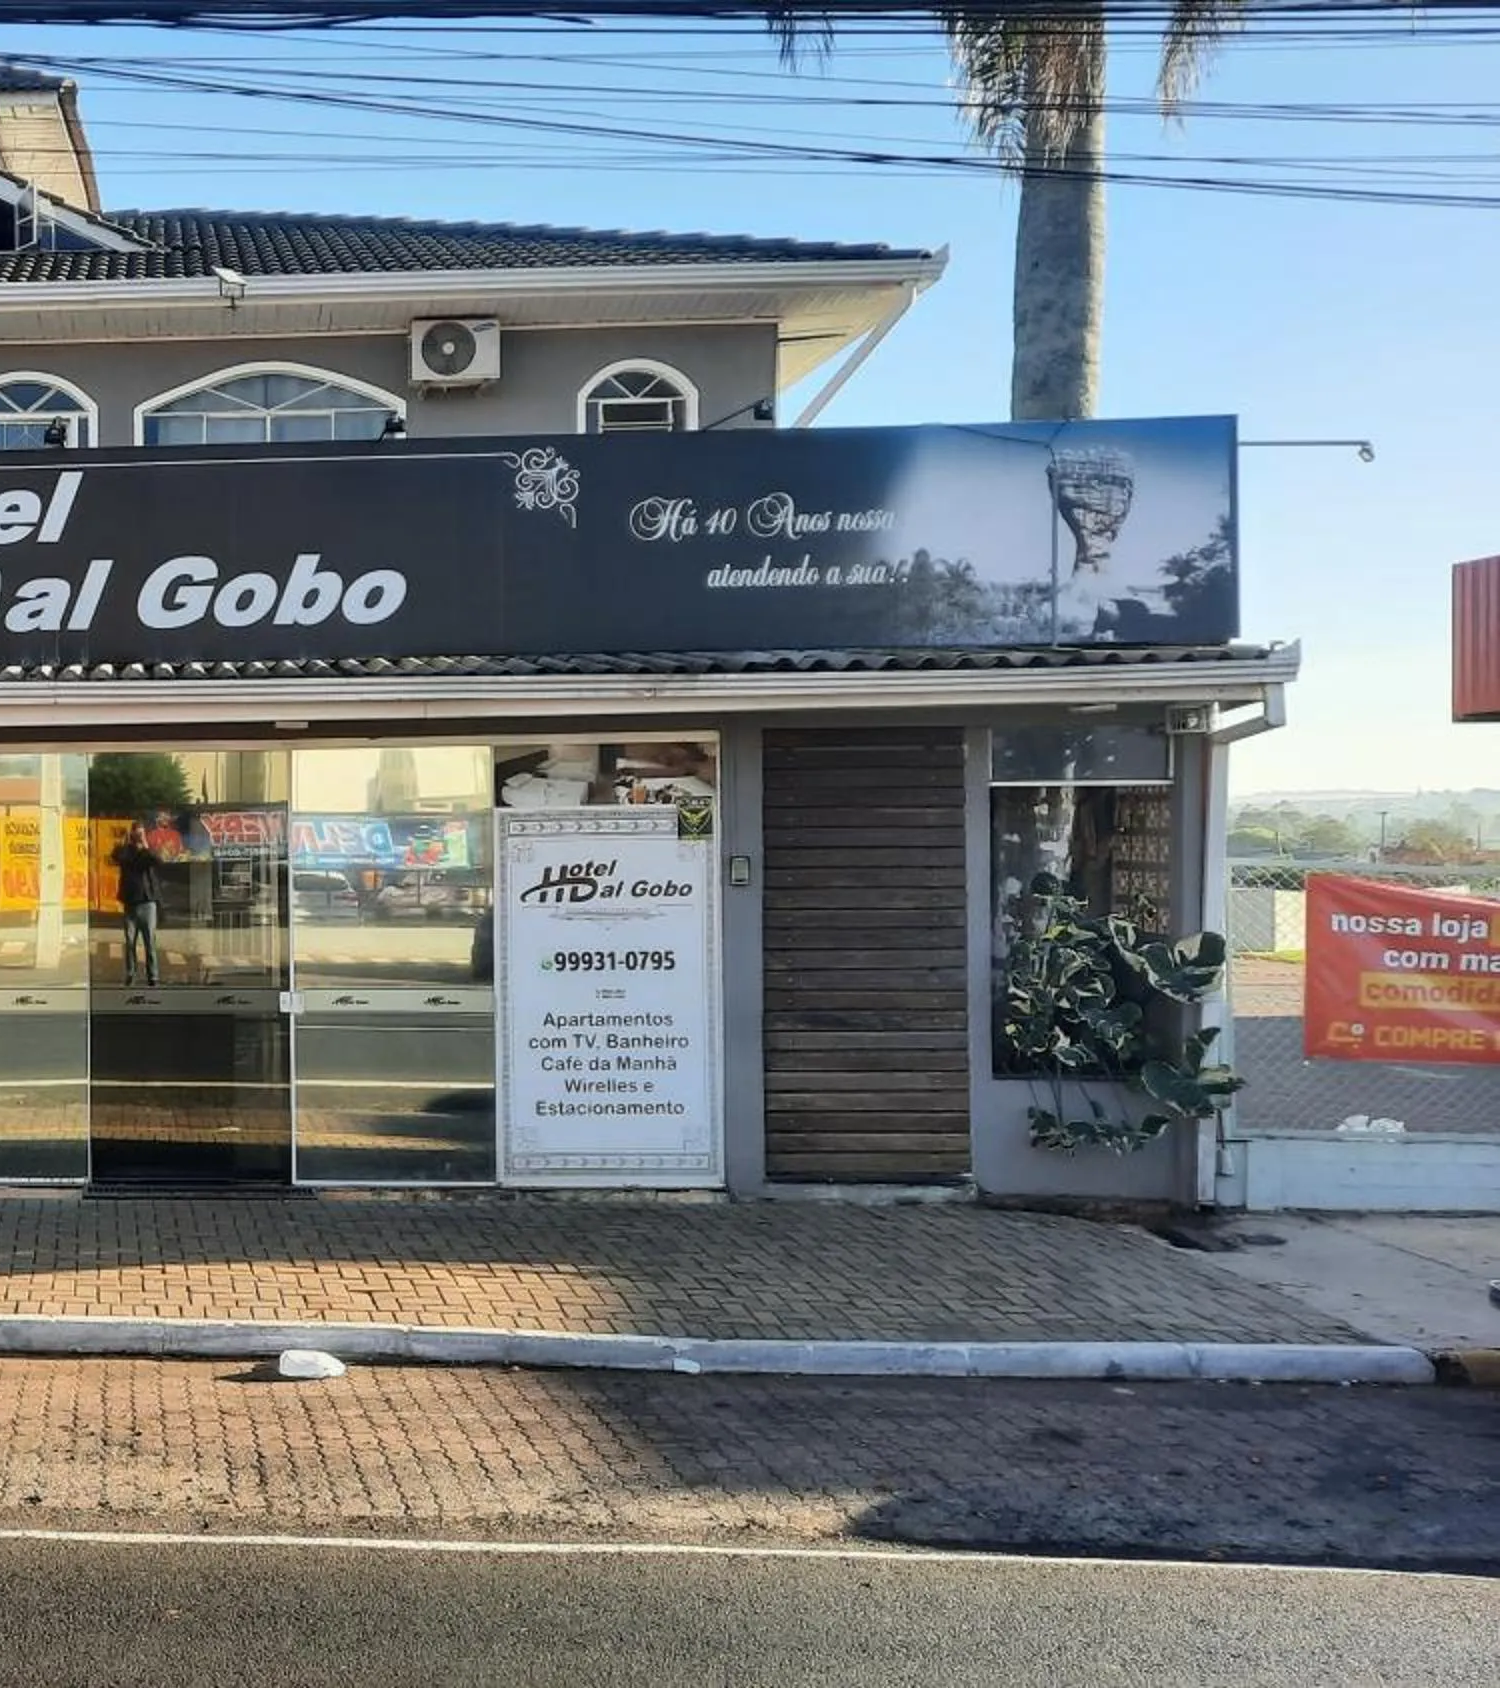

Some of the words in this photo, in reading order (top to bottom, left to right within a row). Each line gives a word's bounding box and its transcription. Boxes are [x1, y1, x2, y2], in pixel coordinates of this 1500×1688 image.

[629, 496, 698, 542] Há
[705, 508, 738, 535] 40
[747, 492, 831, 540] Anos
[837, 508, 896, 532] nossa
[706, 553, 820, 588] atendendo
[825, 563, 841, 586] a
[137, 553, 408, 629] Gobo
[631, 879, 693, 898] Gobo
[1331, 913, 1423, 936] nossa
[1432, 911, 1489, 943] loja
[554, 951, 675, 971] 99931-0795
[1383, 949, 1449, 969] com
[543, 1012, 673, 1029] Apartamentos
[529, 1037, 567, 1049] com
[606, 1033, 689, 1049] Banheiro
[1374, 1025, 1485, 1049] COMPRE
[589, 1057, 611, 1071] da
[617, 1055, 677, 1071] Manhã
[643, 1081, 654, 1093] e
[535, 1100, 685, 1116] Estacionamento
